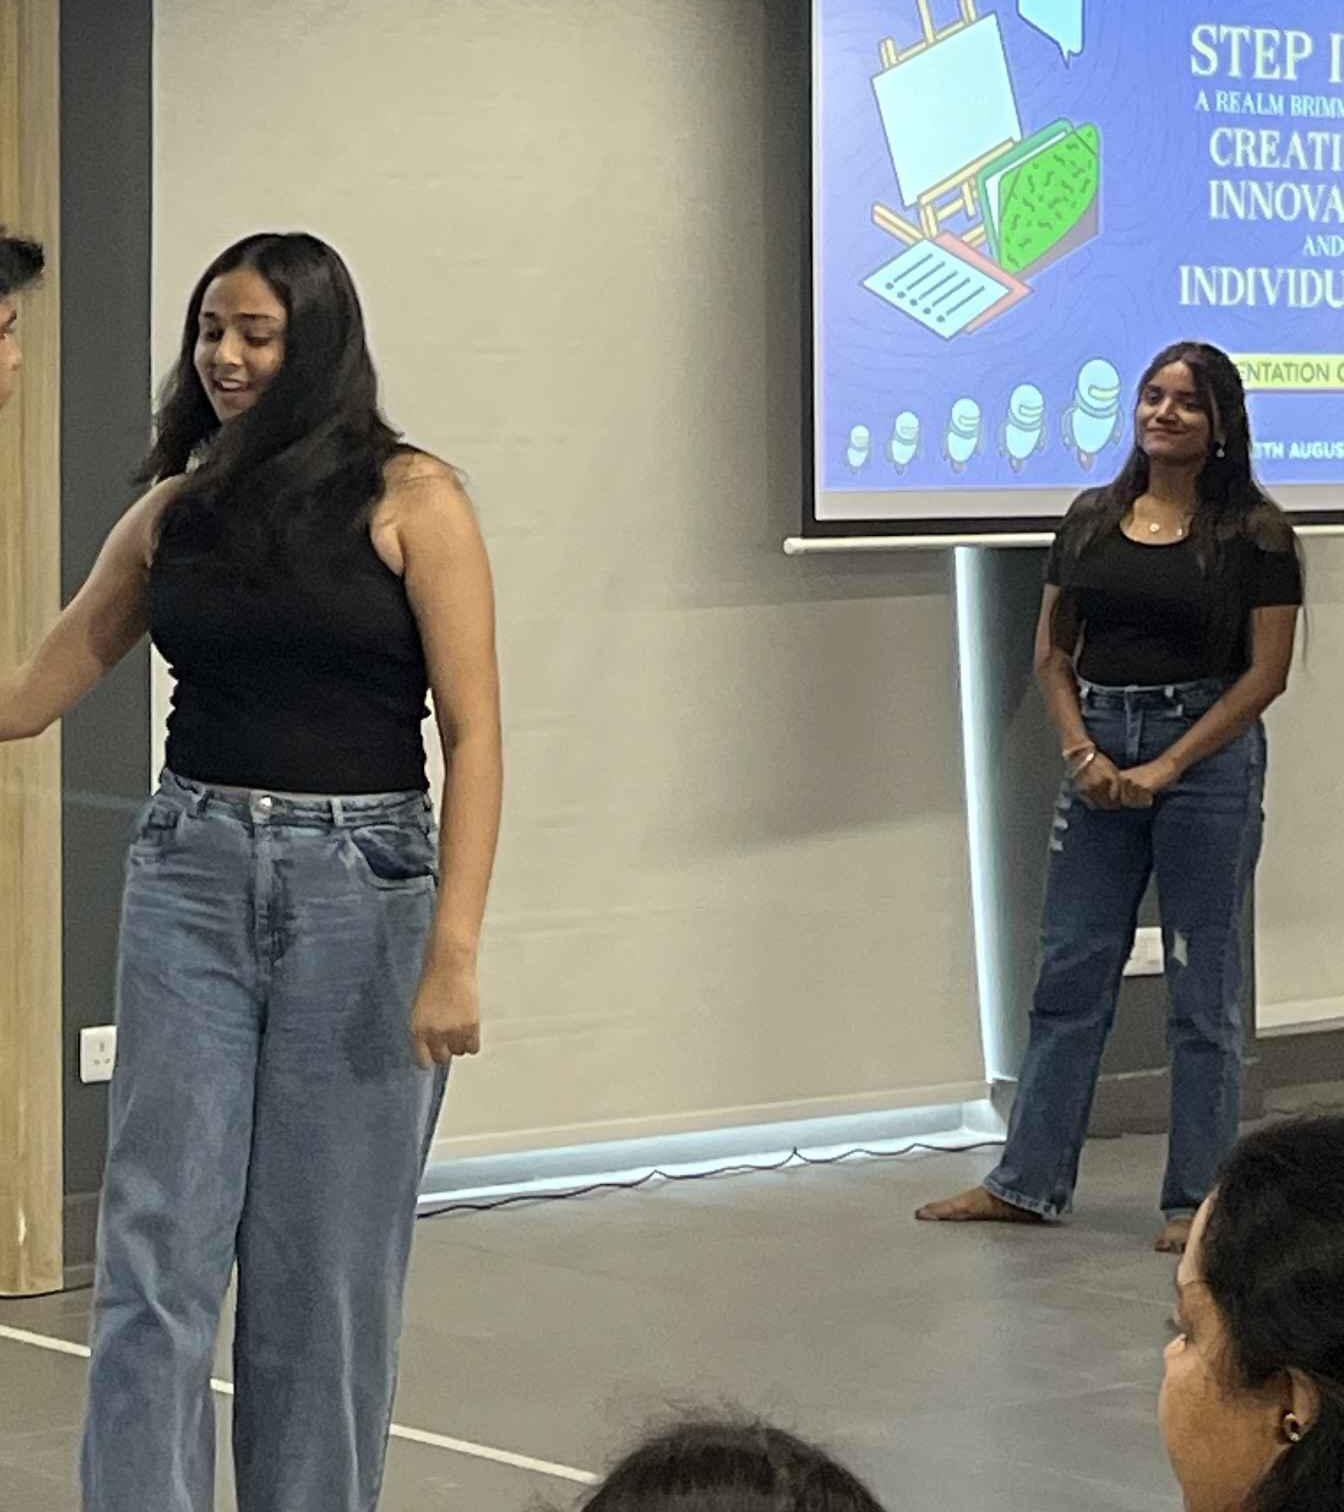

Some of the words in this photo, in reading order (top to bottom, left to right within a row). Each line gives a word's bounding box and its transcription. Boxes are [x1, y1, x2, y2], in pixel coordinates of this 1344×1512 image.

[1190, 24, 1313, 81] STEP
[1195, 88, 1211, 112] A
[1215, 90, 1284, 116] REALM
[1209, 127, 1344, 172] CREATI
[1208, 180, 1344, 224] INNOVA
[1302, 233, 1344, 257] AND
[1178, 264, 1344, 309] INDIVIDU
[1289, 440, 1344, 461] AUGUS
